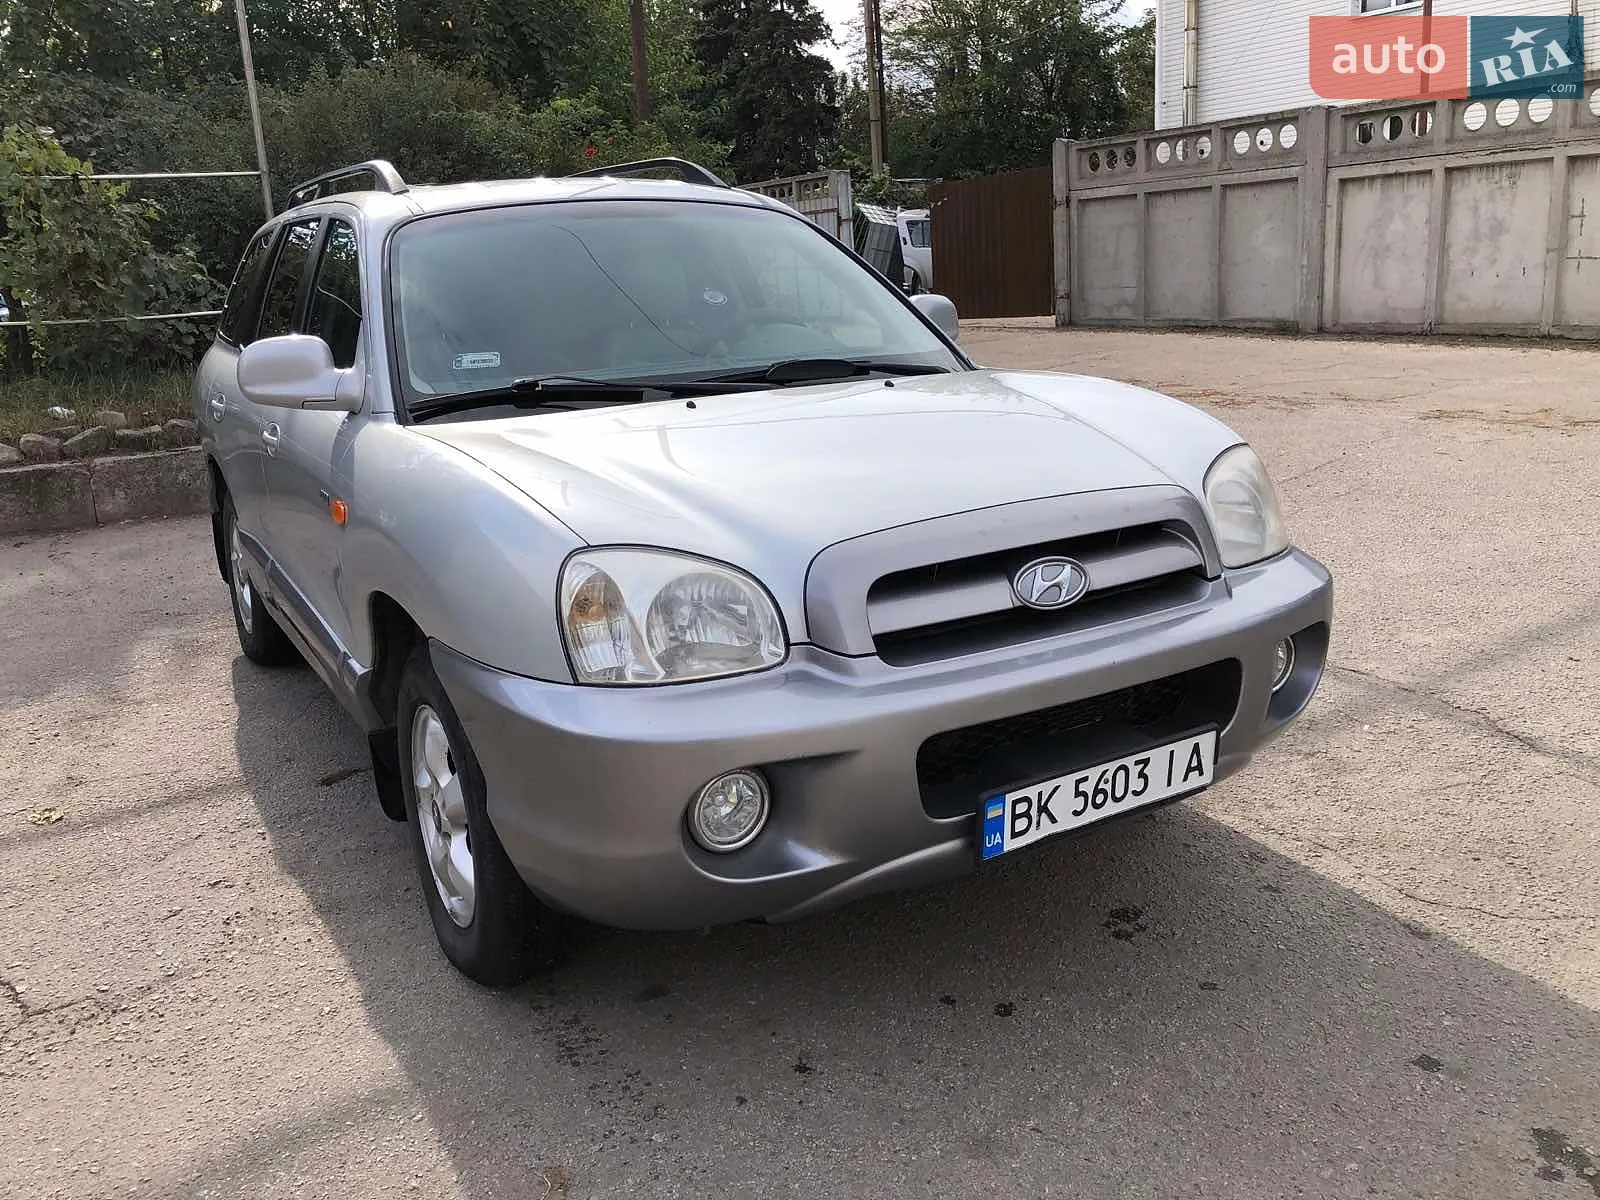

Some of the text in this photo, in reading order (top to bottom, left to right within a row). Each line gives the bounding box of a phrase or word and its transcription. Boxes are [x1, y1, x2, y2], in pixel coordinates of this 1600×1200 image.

[1010, 784, 1061, 840] BK
[1071, 756, 1151, 817] 5603
[985, 832, 1002, 848] UA
